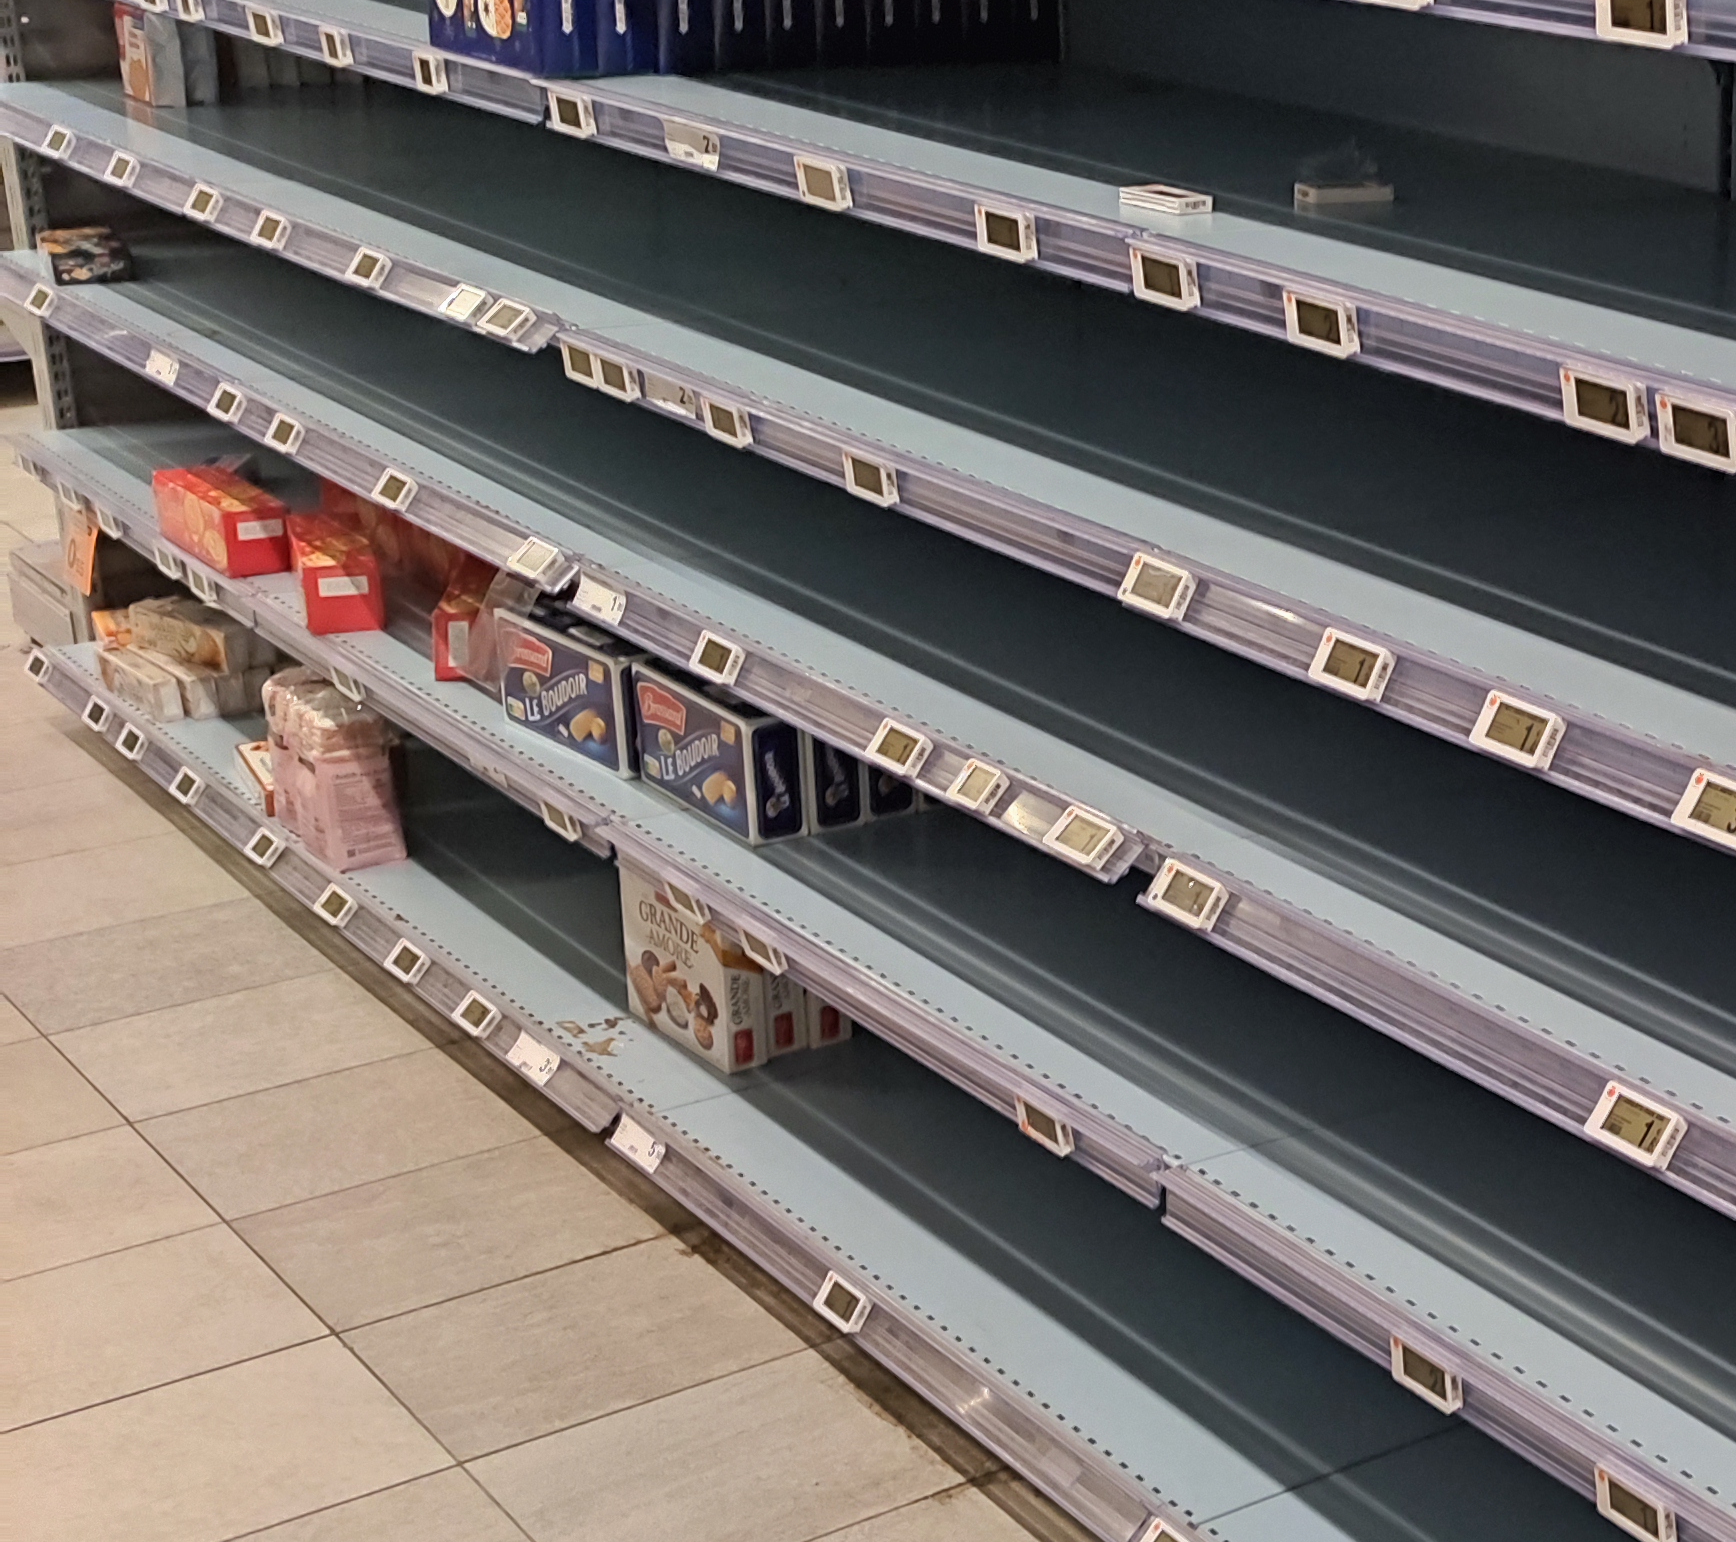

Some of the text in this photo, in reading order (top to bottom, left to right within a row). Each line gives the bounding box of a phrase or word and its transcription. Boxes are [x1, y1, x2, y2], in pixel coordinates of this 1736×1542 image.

[541, 672, 588, 716] BOUDOIR
[660, 732, 720, 781] LE BOUDOIR
[639, 899, 699, 955] GRANDE
[645, 927, 694, 969] AMORE
